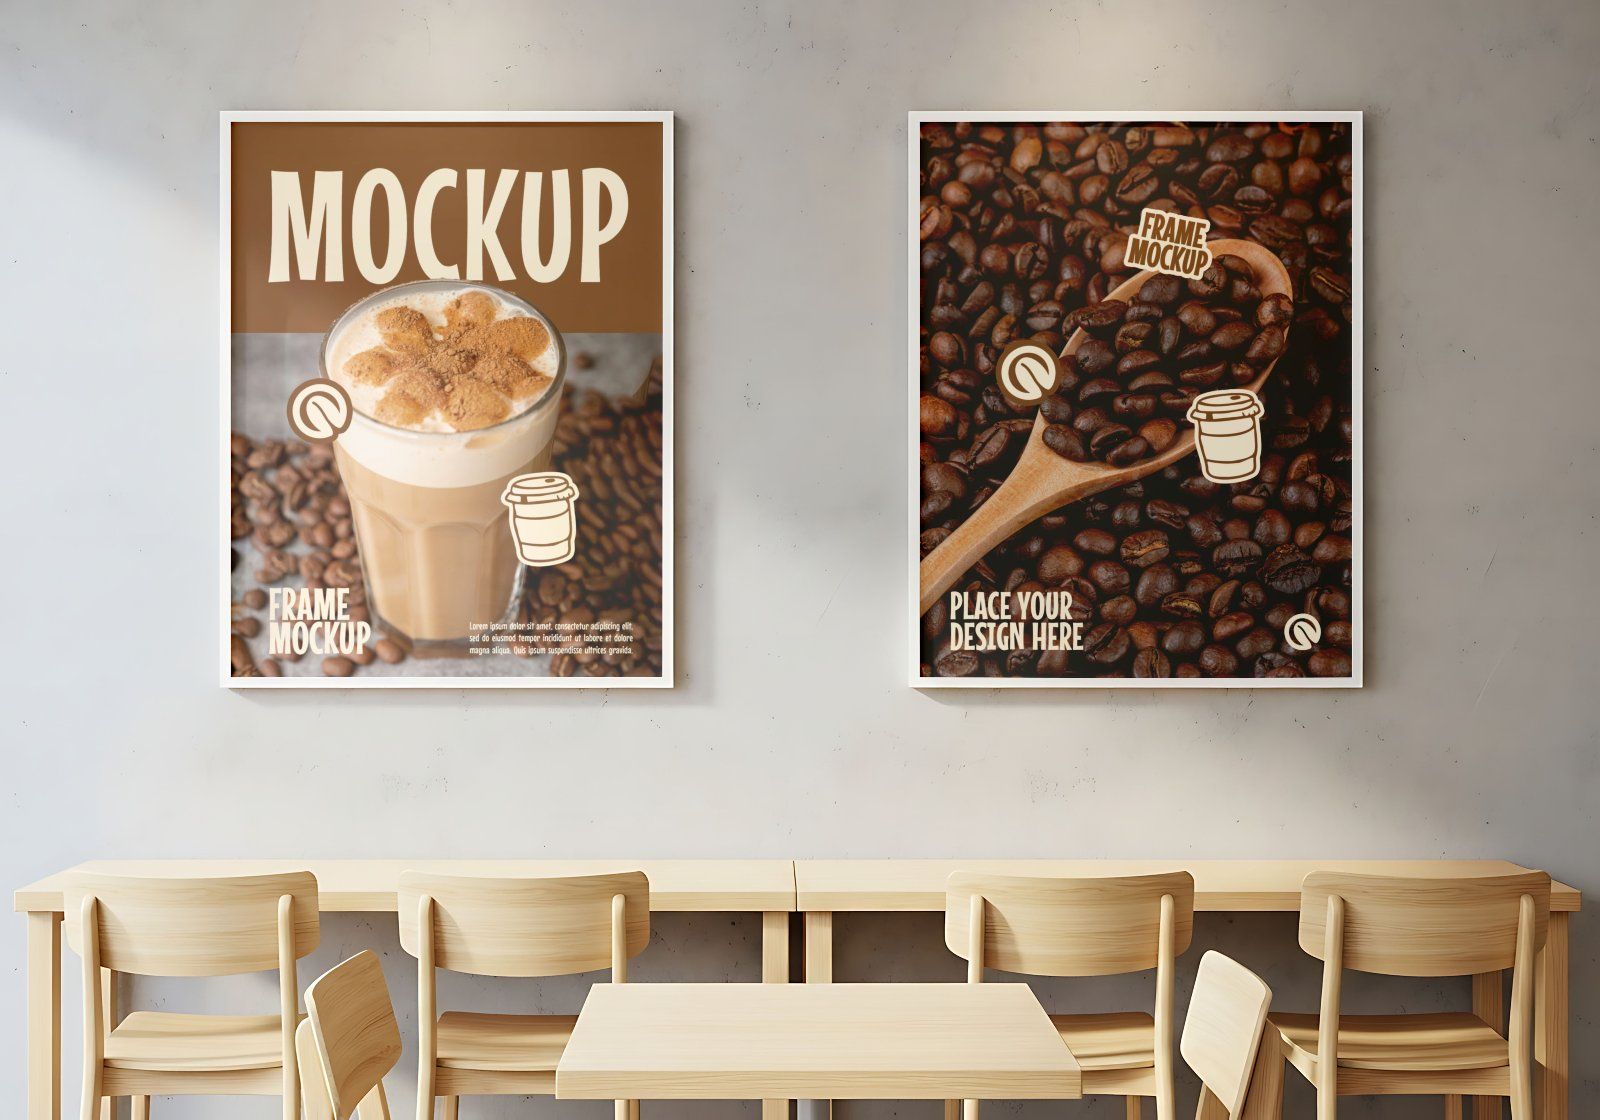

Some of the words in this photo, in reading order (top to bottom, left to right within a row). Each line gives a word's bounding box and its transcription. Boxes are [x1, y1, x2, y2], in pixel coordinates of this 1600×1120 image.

[268, 167, 629, 285] MOCKUP
[1141, 212, 1206, 249] FRAME
[1127, 238, 1209, 276] MOCKUP
[269, 587, 350, 621] FRAME
[950, 591, 1011, 620] PLACE
[1017, 591, 1073, 620] YOUR
[269, 621, 371, 655] MOCKUP
[469, 622, 488, 631] Lorem
[490, 622, 508, 632] ipsum
[509, 622, 525, 630] dolor
[527, 622, 535, 631] sit
[554, 622, 589, 630] consectetur
[590, 622, 620, 631] adipiscing
[469, 634, 480, 642] sed
[481, 634, 490, 642] do
[492, 634, 516, 642] eiusmod
[518, 634, 541, 643] tempor
[542, 634, 573, 642] incididunt
[574, 634, 582, 642] ut
[583, 634, 604, 642] labore
[605, 634, 612, 642] et
[613, 634, 634, 642] dolore
[950, 622, 1024, 651] DESIGN
[1032, 622, 1083, 651] HERE
[469, 646, 490, 655] magna
[513, 646, 527, 655] Quis
[528, 646, 546, 655] ipsum
[548, 646, 582, 655] suspendisse
[584, 646, 607, 654] ultrices
[608, 646, 634, 655] gravida.
